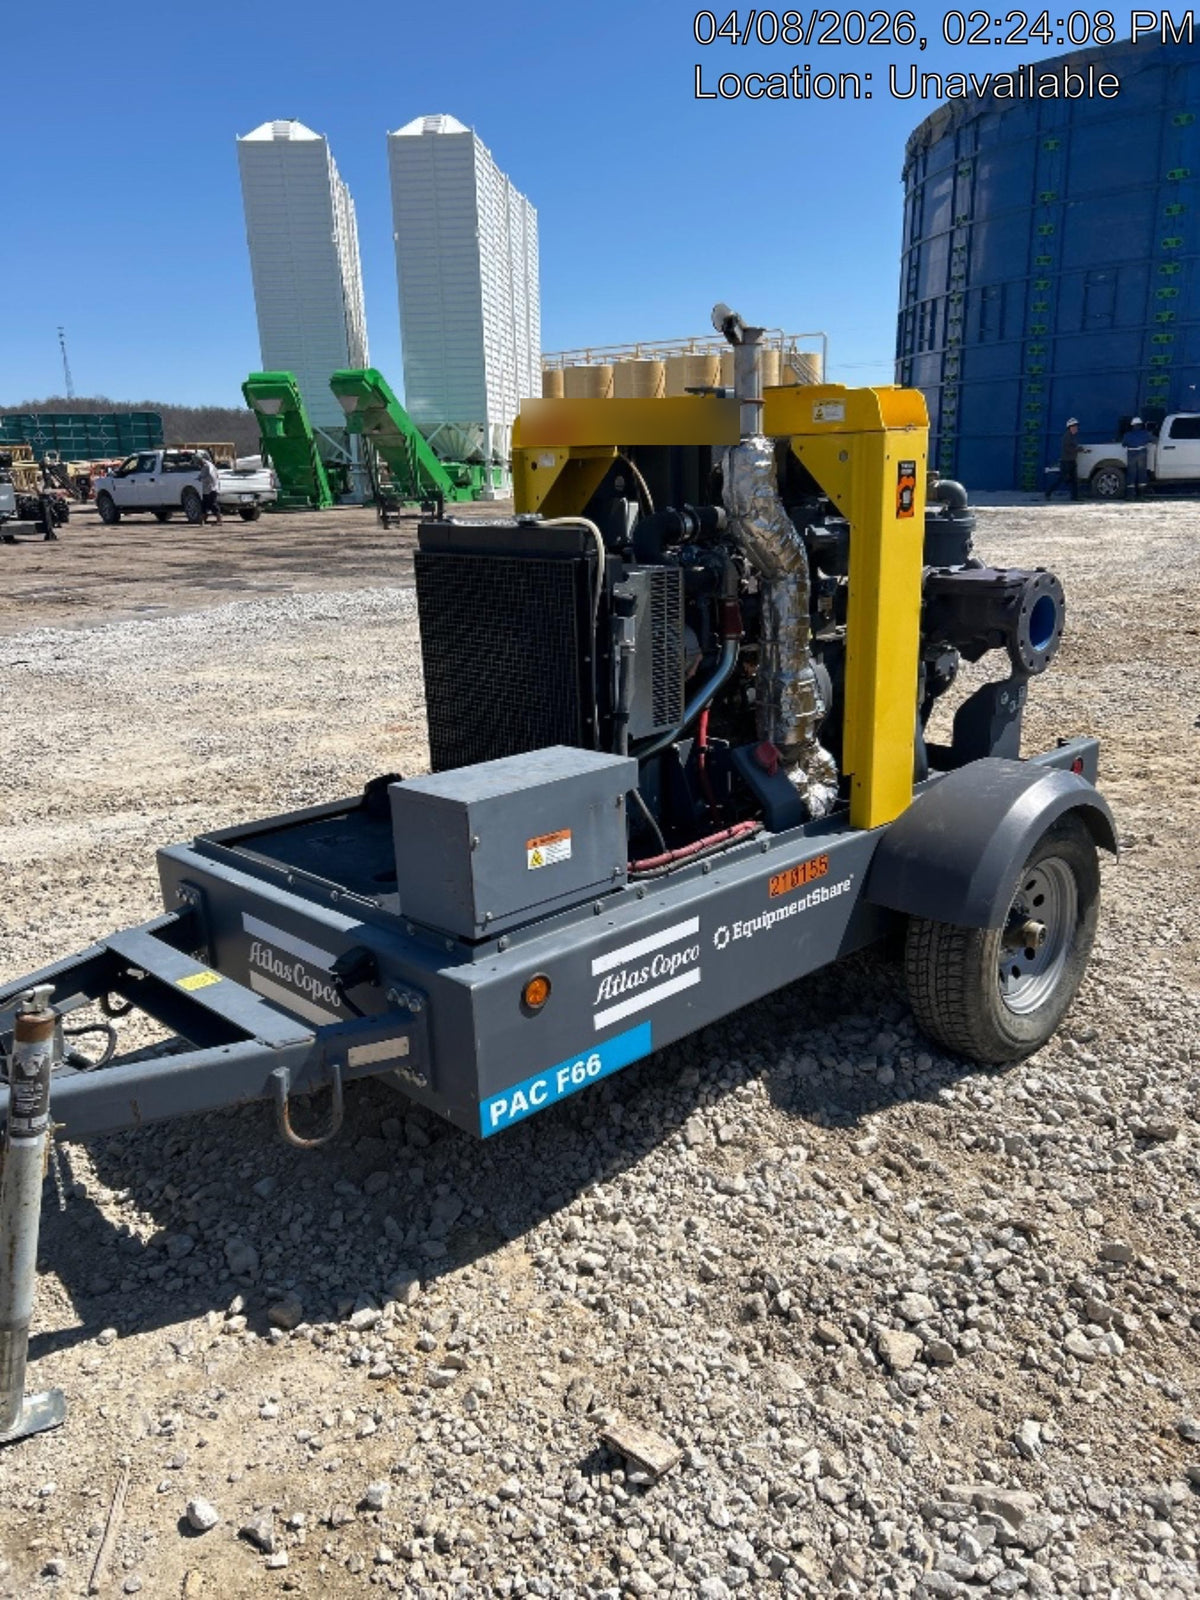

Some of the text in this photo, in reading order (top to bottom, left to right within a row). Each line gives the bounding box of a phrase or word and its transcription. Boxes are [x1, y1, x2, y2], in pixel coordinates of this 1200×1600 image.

[732, 878, 852, 940] EquipmentShare
[249, 941, 341, 1007] Atlas Copco
[593, 944, 700, 1006] Atlas Copco
[489, 1053, 602, 1127] PAC F66
